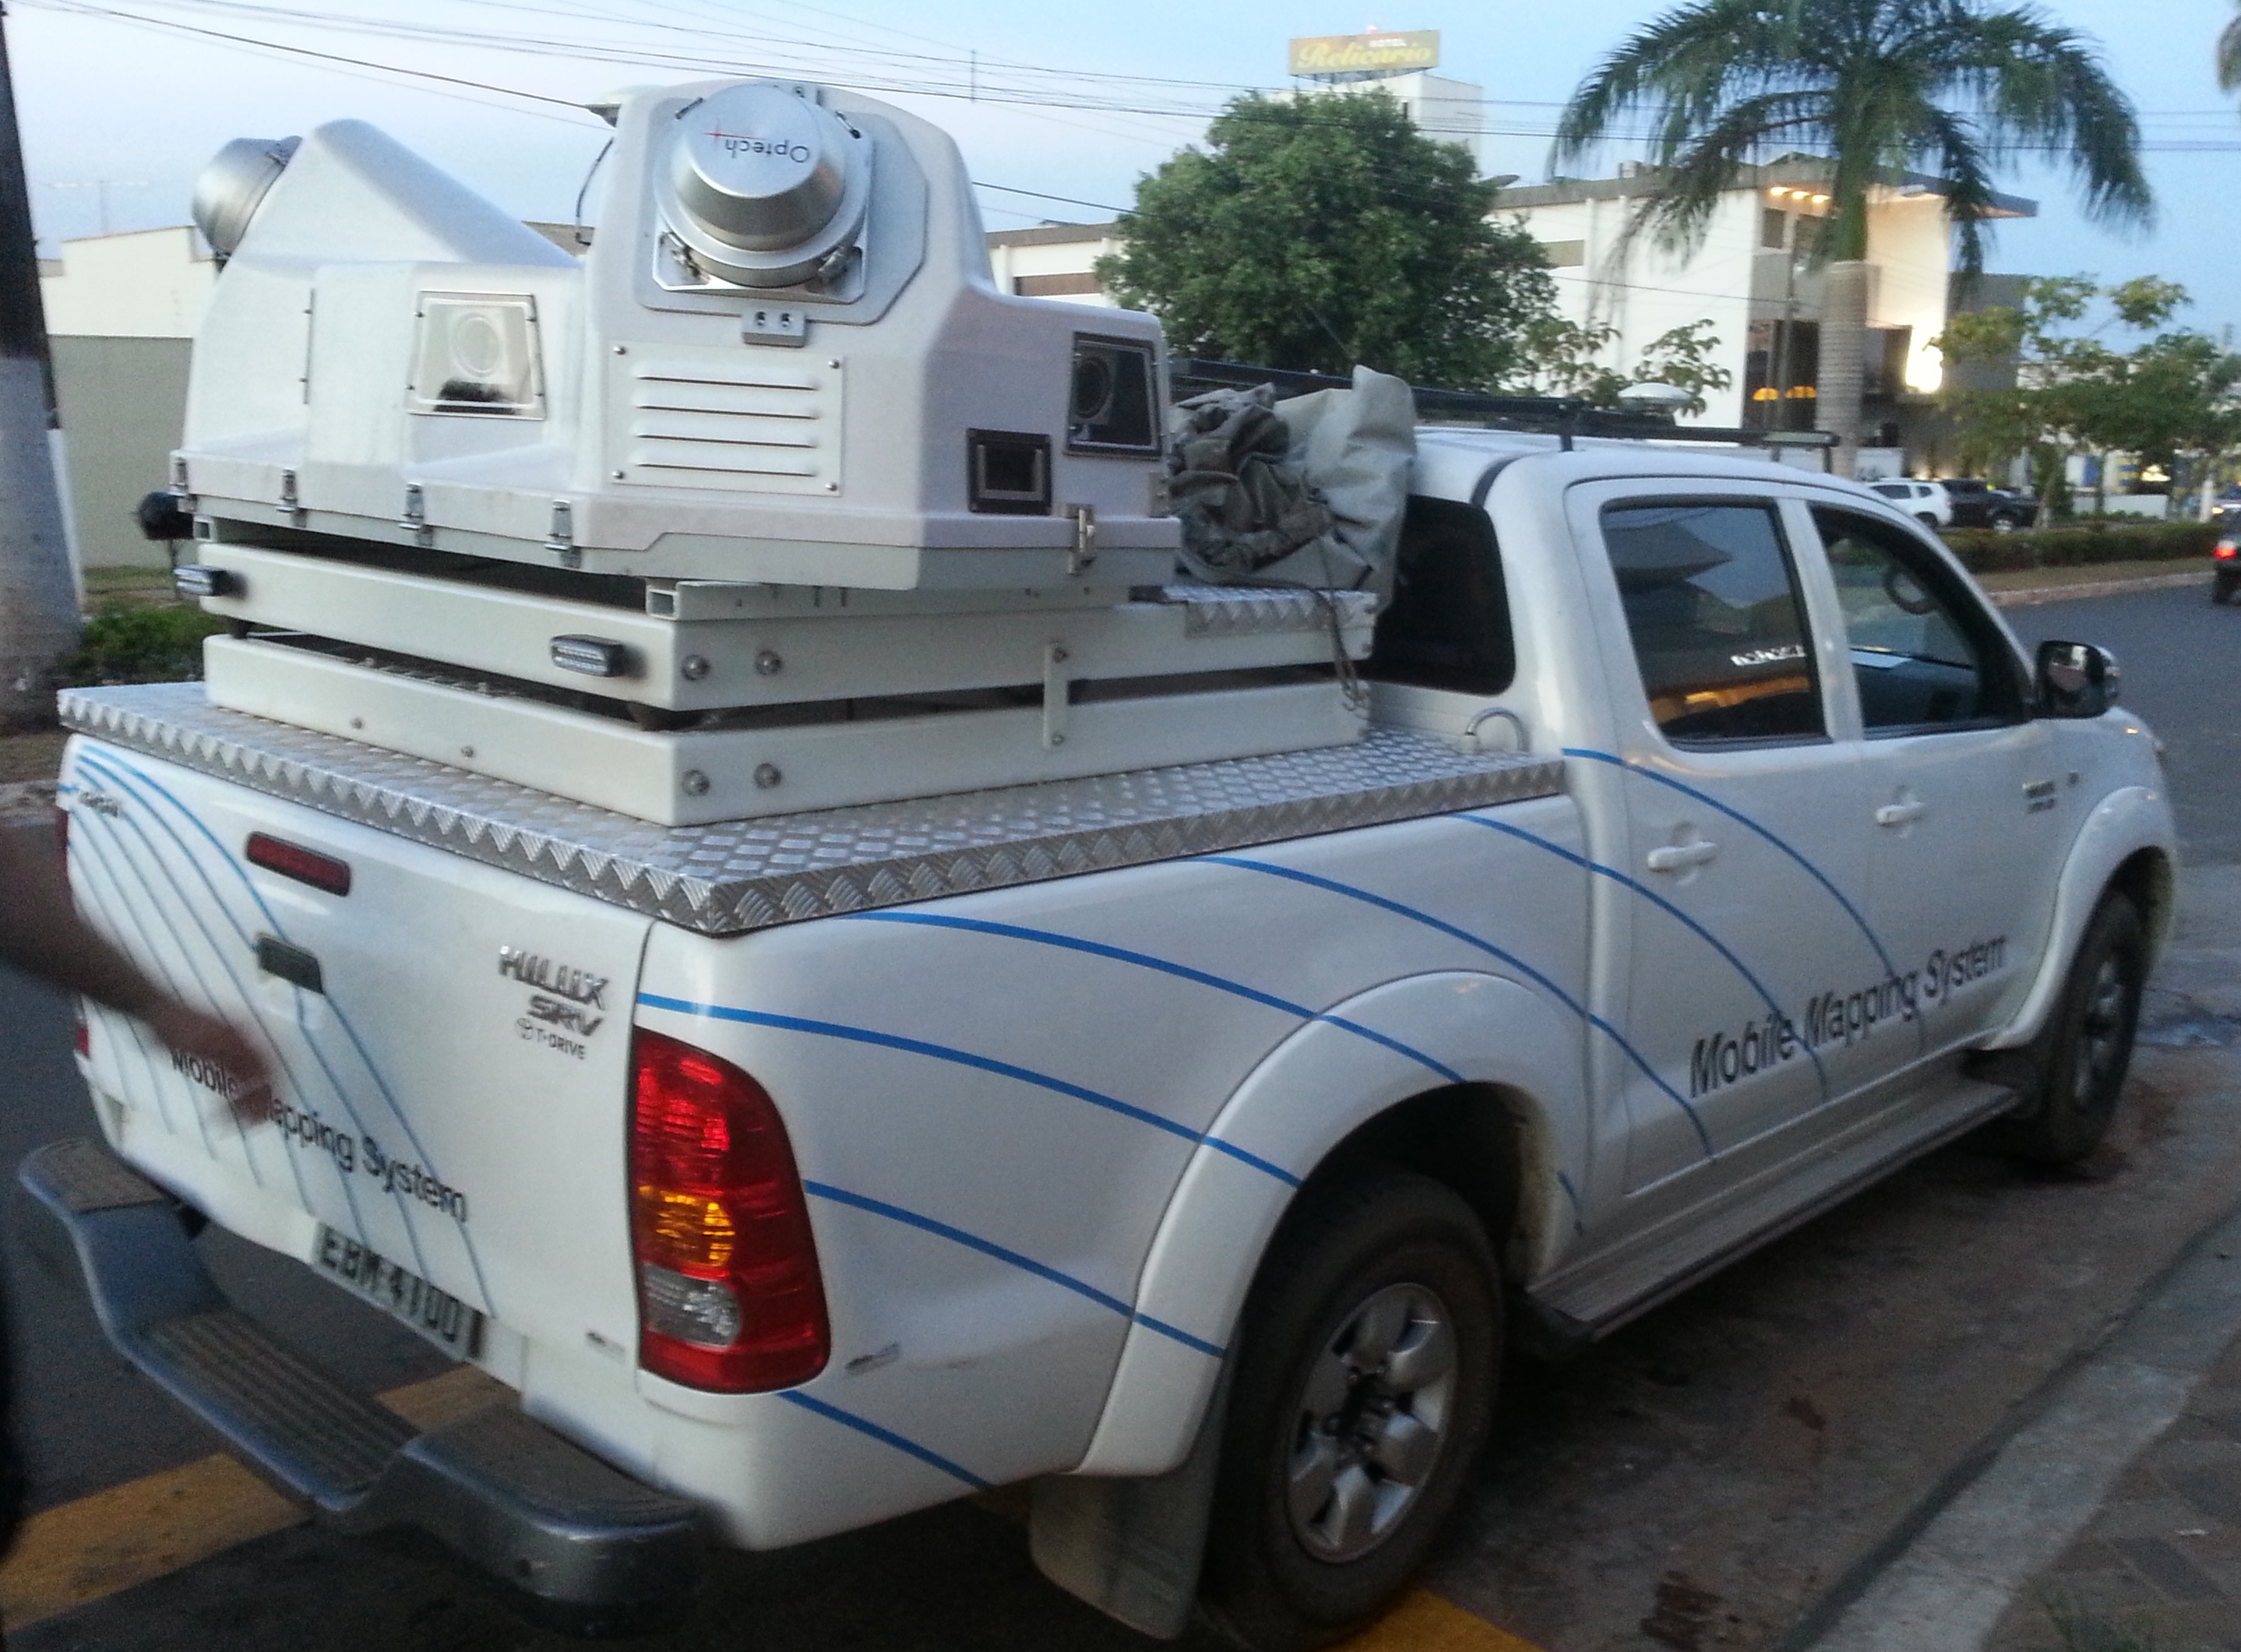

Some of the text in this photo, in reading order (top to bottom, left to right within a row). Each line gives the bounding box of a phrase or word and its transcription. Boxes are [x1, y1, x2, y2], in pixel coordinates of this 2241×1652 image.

[724, 138, 810, 164] Optech
[1690, 936, 2007, 1098] Mobile Mapping System
[263, 1083, 353, 1172] apping
[361, 1136, 469, 1224] System
